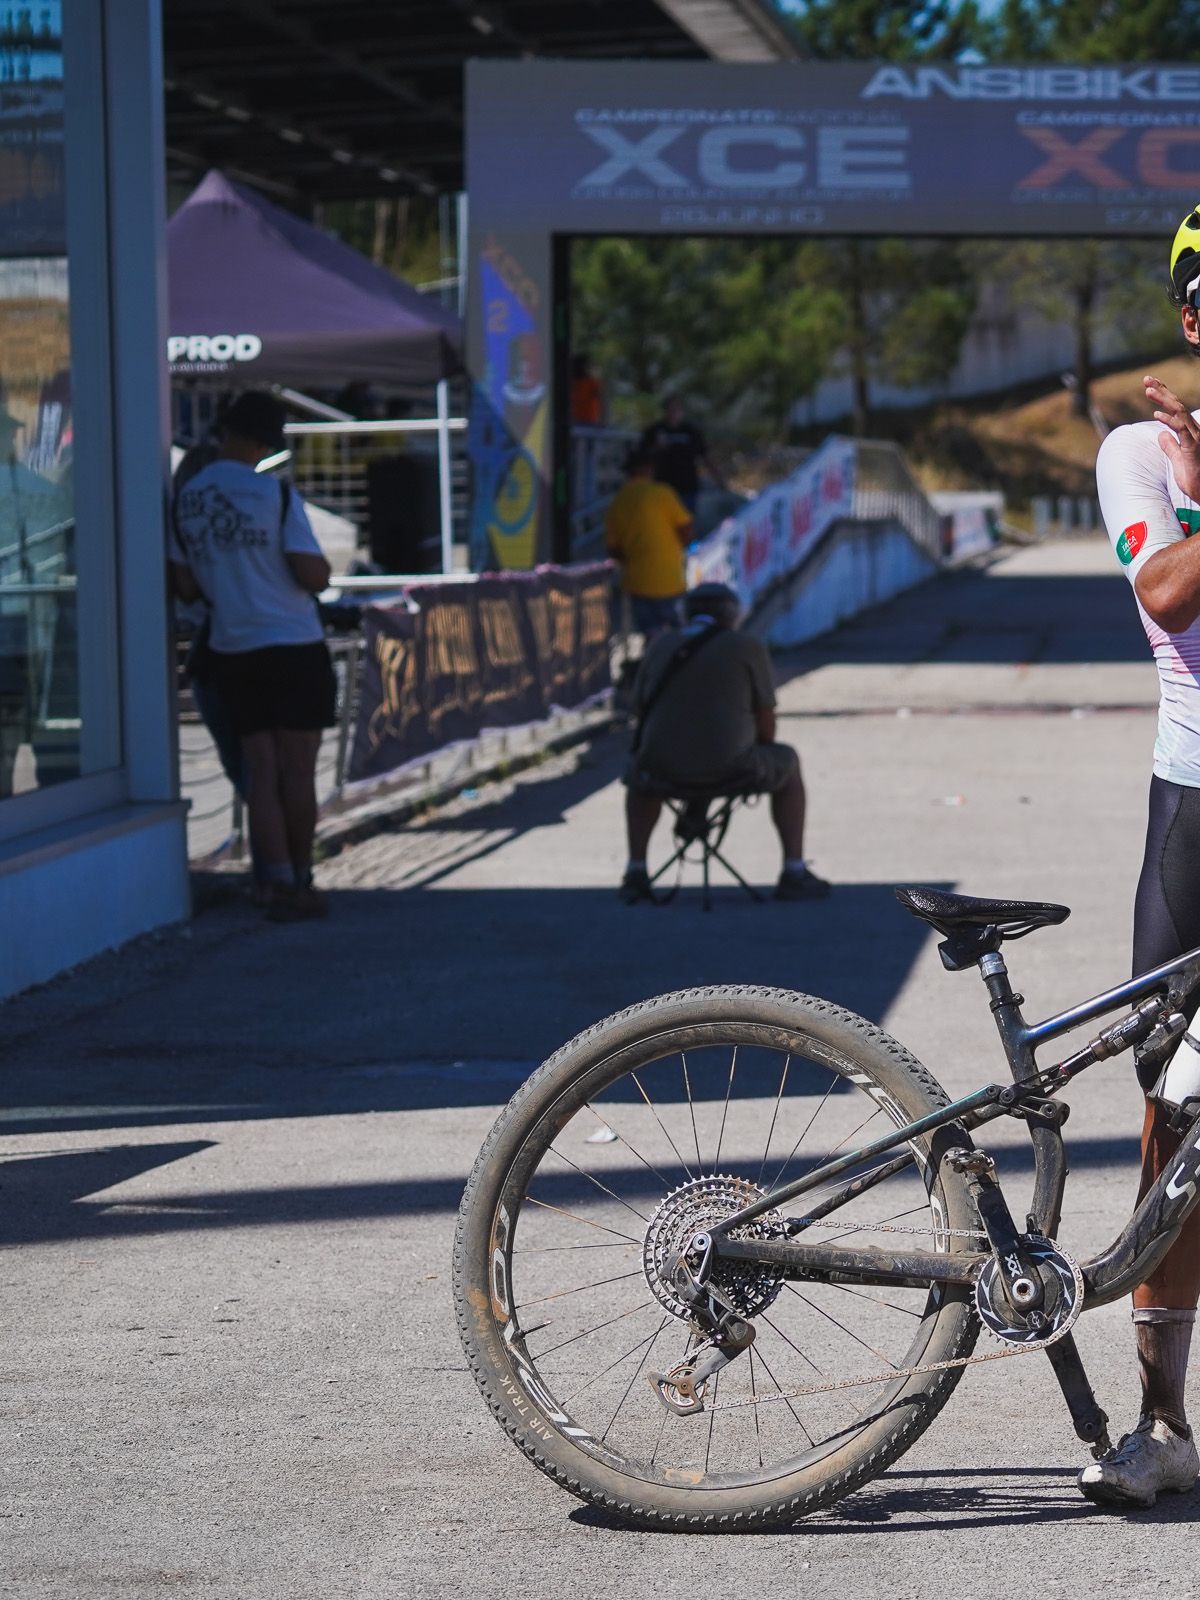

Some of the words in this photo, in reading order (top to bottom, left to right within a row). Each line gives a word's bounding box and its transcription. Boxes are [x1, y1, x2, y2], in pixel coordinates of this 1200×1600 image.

[576, 126, 911, 188] XCE
[167, 334, 262, 362] PROD
[499, 1374, 530, 1416] TRAK
[528, 1417, 554, 1442] AIR
